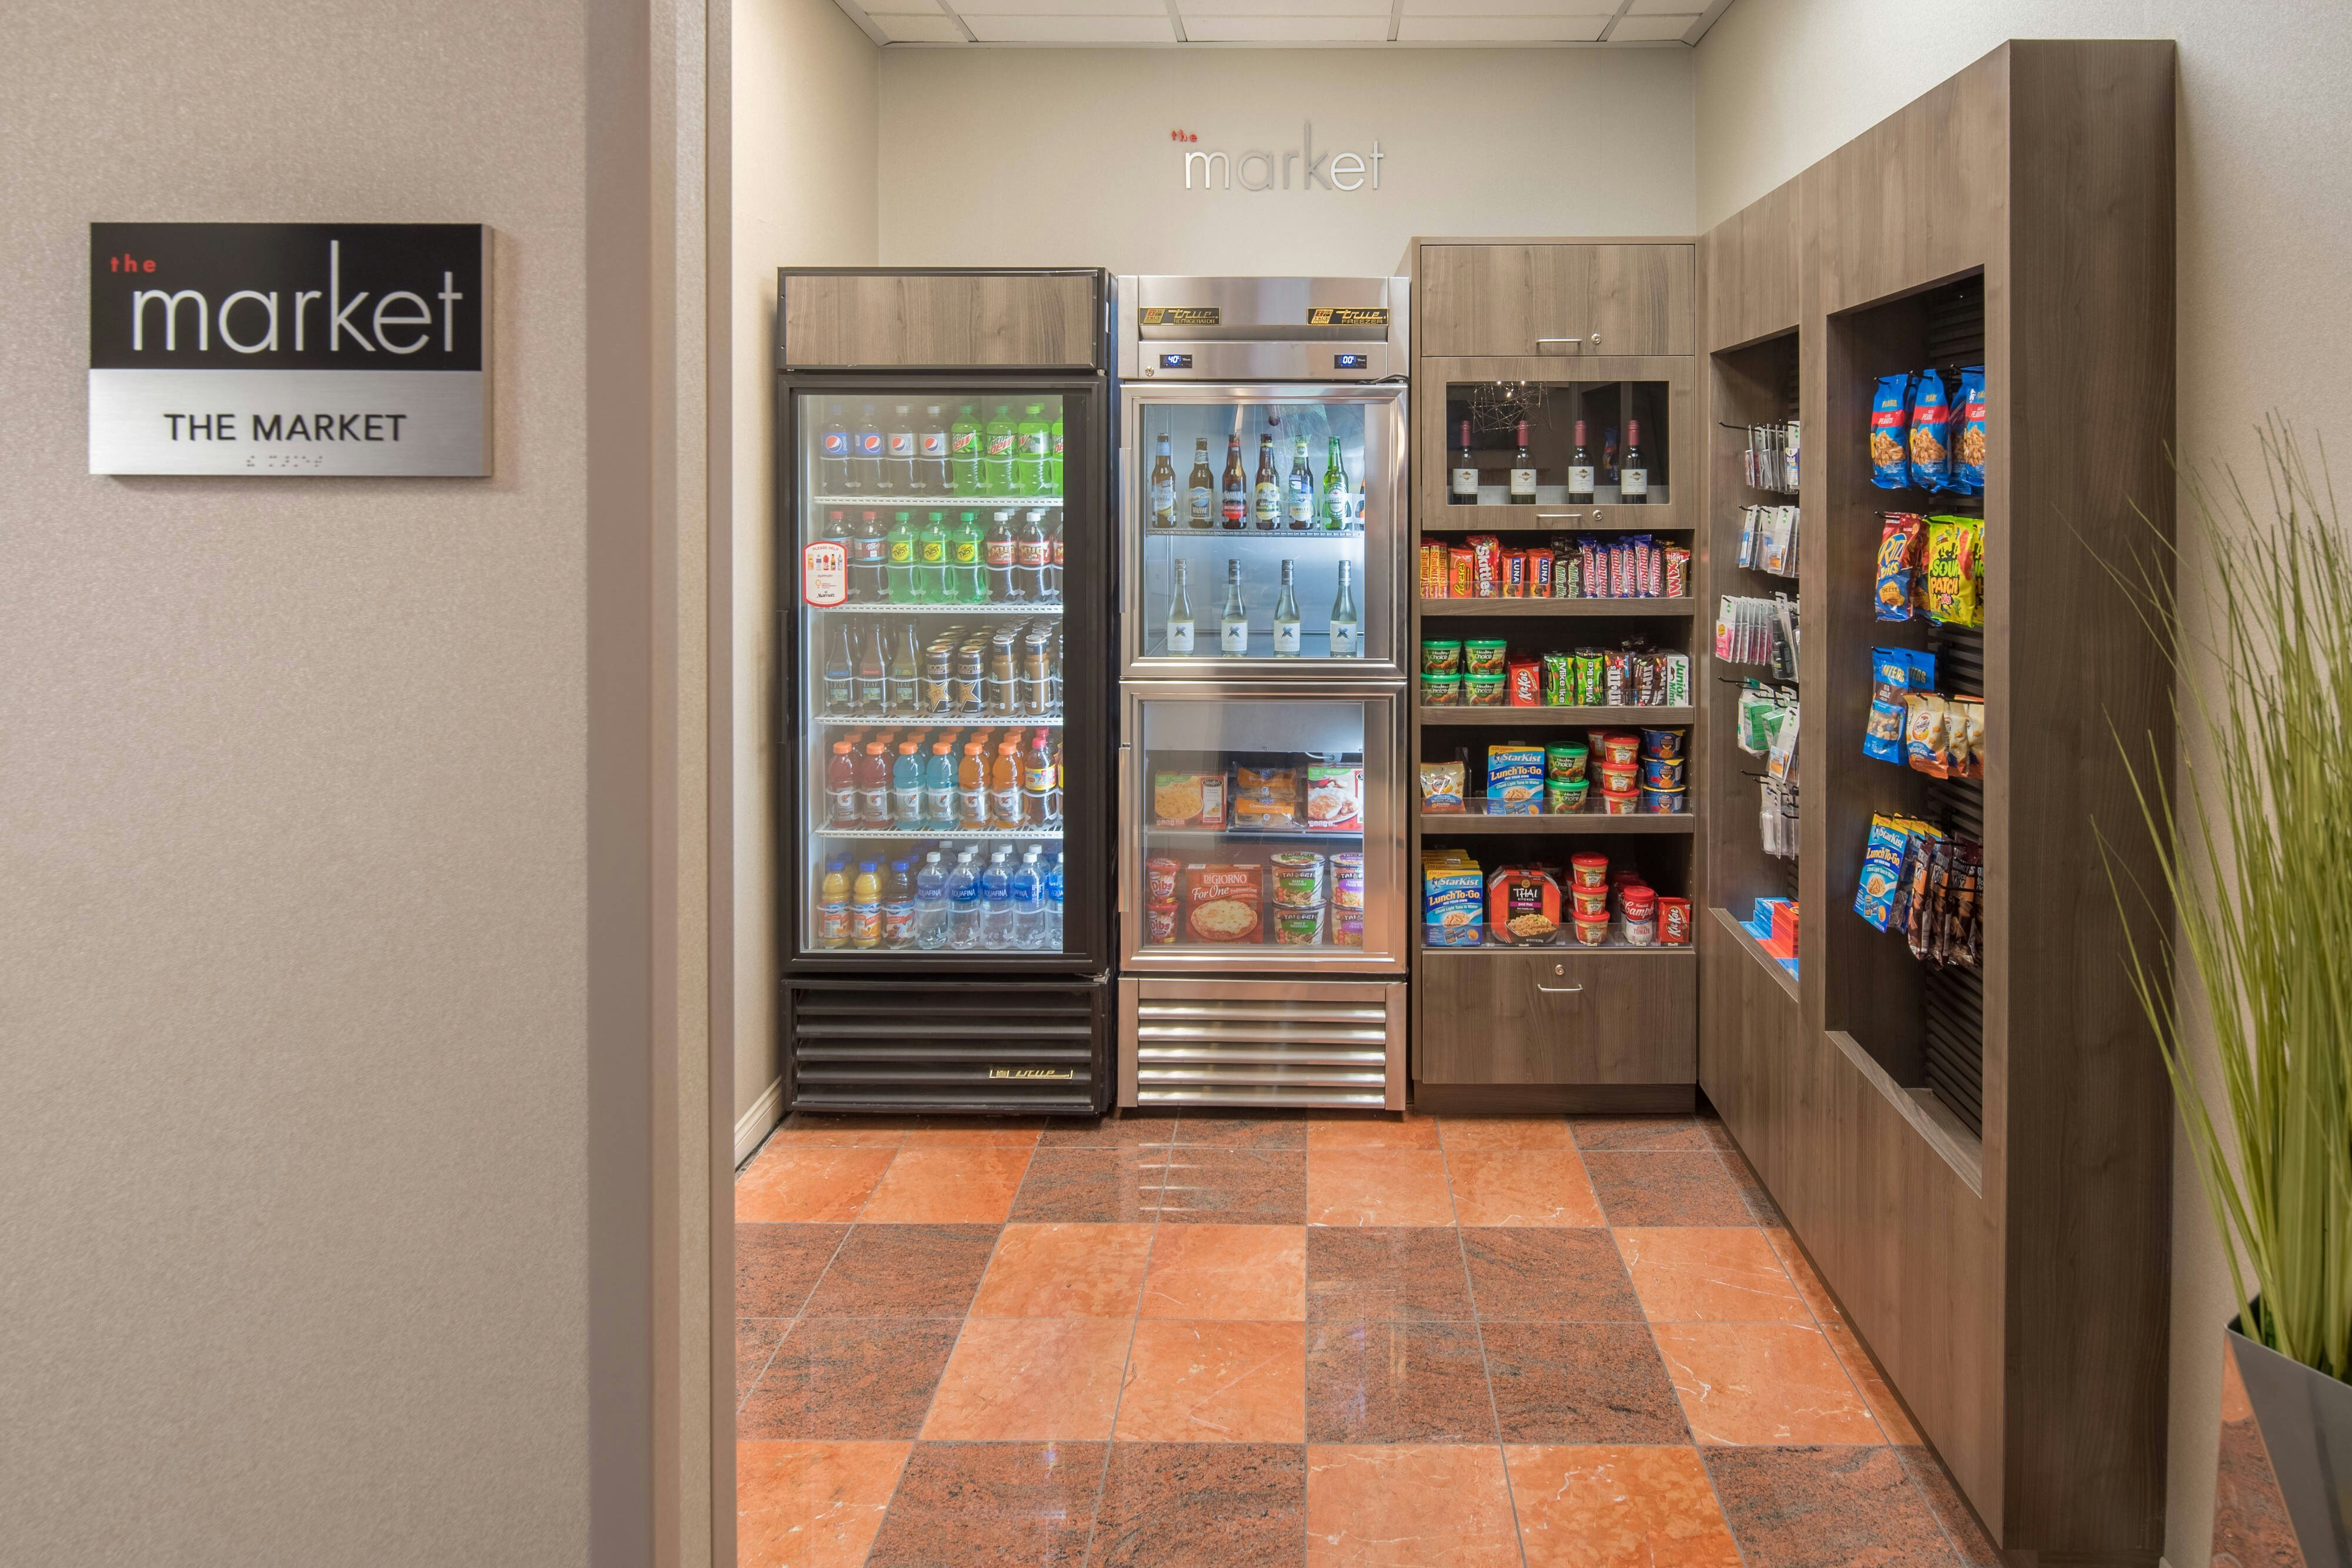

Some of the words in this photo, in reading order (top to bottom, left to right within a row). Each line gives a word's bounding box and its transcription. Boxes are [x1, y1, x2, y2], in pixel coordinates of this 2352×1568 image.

[1171, 130, 1197, 142] the
[1185, 122, 1385, 191] market
[110, 254, 156, 273] the
[133, 240, 463, 353] market
[164, 414, 236, 442] THE
[253, 414, 407, 442] MARKET
[1476, 545, 1492, 597] Skittles
[1932, 559, 1959, 577] SOUR
[1454, 562, 1465, 596] Reese's
[1668, 562, 1683, 598] TWIX
[1930, 577, 1959, 595] PATCH
[1676, 660, 1686, 700] Junior
[1586, 678, 1594, 702] Mike
[1502, 753, 1542, 762] StarKist
[1490, 767, 1517, 781] Lunch
[1879, 827, 1903, 848] StarKist
[1866, 847, 1885, 859] Lunch
[1151, 880, 1173, 890] Dibs
[1439, 877, 1479, 885] StarKist
[918, 888, 941, 897] AQUAFINA
[951, 888, 975, 897] AQUAFINA
[984, 888, 1007, 897] AQUAFINA
[1192, 887, 1208, 901] For
[1209, 885, 1229, 898] One
[1429, 891, 1455, 906] Lunch
[1514, 888, 1537, 898] THAI
[1151, 920, 1170, 930] Dibs
